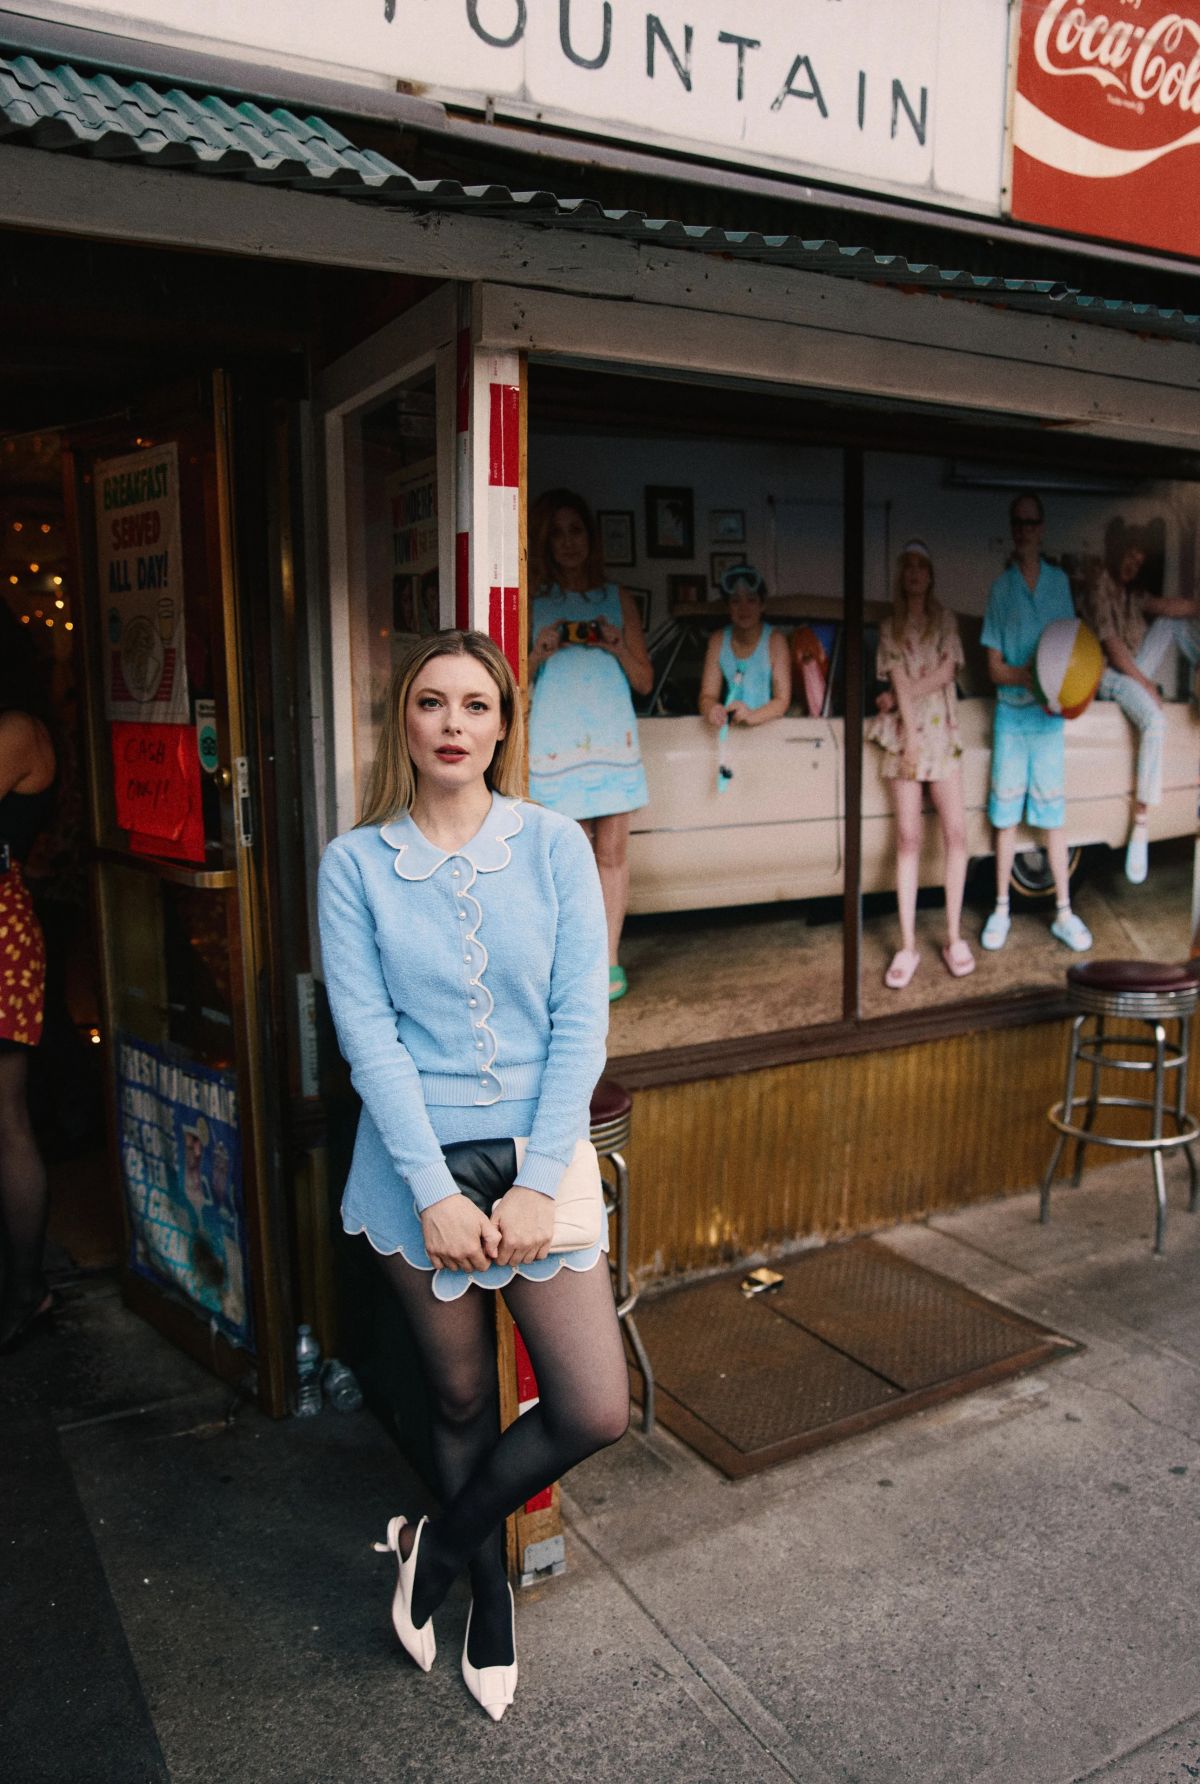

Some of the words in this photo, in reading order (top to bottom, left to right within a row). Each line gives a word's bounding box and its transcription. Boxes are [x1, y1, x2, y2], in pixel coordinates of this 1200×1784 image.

[104, 463, 168, 512] BREAKFAST
[112, 510, 160, 551] SERVED
[109, 559, 131, 593] ALL
[136, 549, 168, 590] DAY!
[124, 738, 166, 765] CASH
